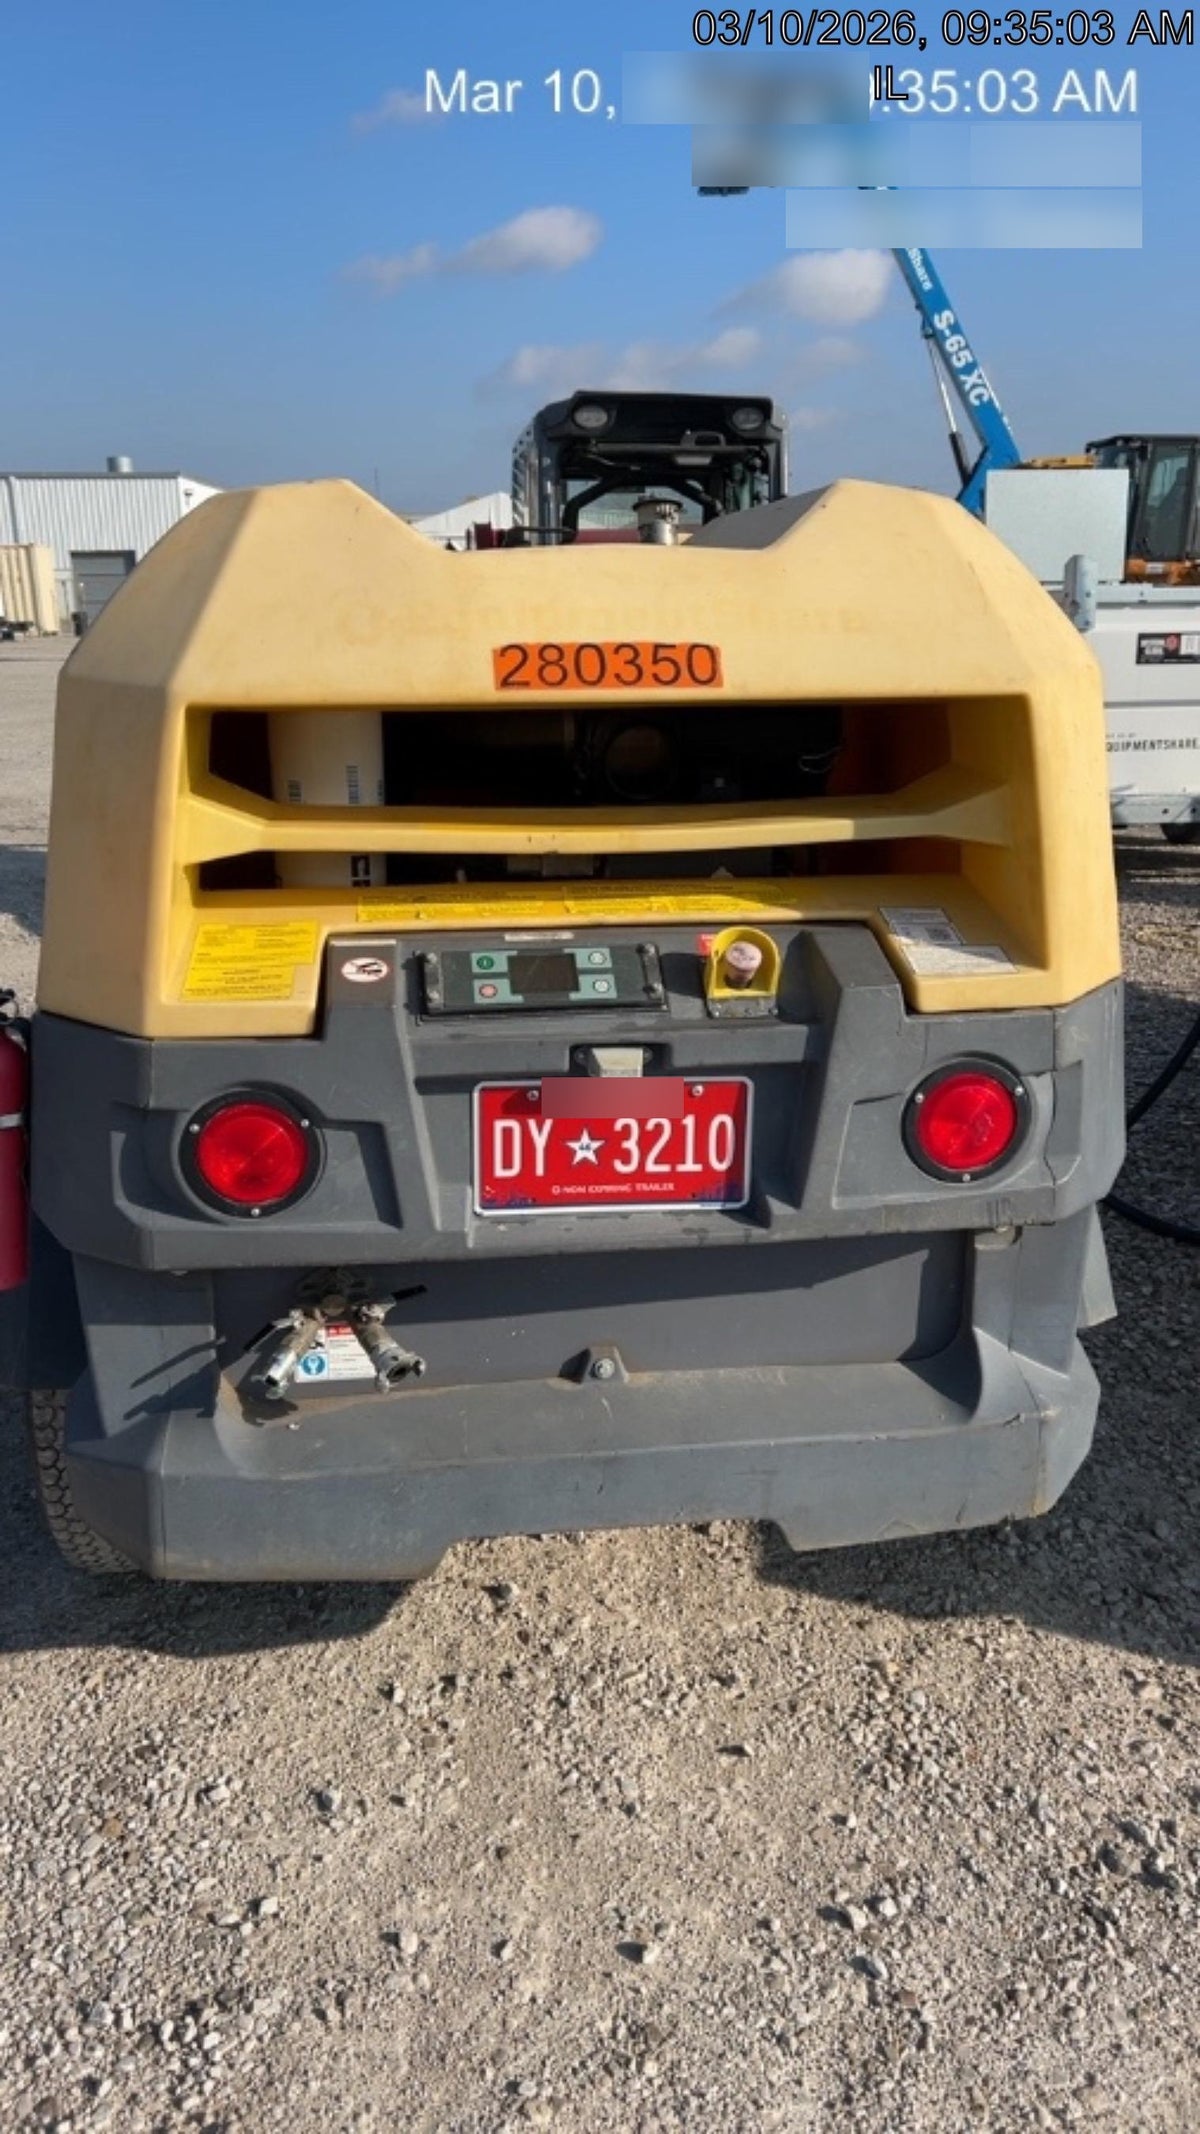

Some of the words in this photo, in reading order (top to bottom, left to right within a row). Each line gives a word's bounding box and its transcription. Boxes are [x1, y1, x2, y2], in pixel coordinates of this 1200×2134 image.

[934, 309, 974, 368] S-65
[960, 367, 990, 407] XC
[499, 642, 719, 688] 280350
[493, 1118, 553, 1178] DY
[613, 1113, 736, 1174] 3210
